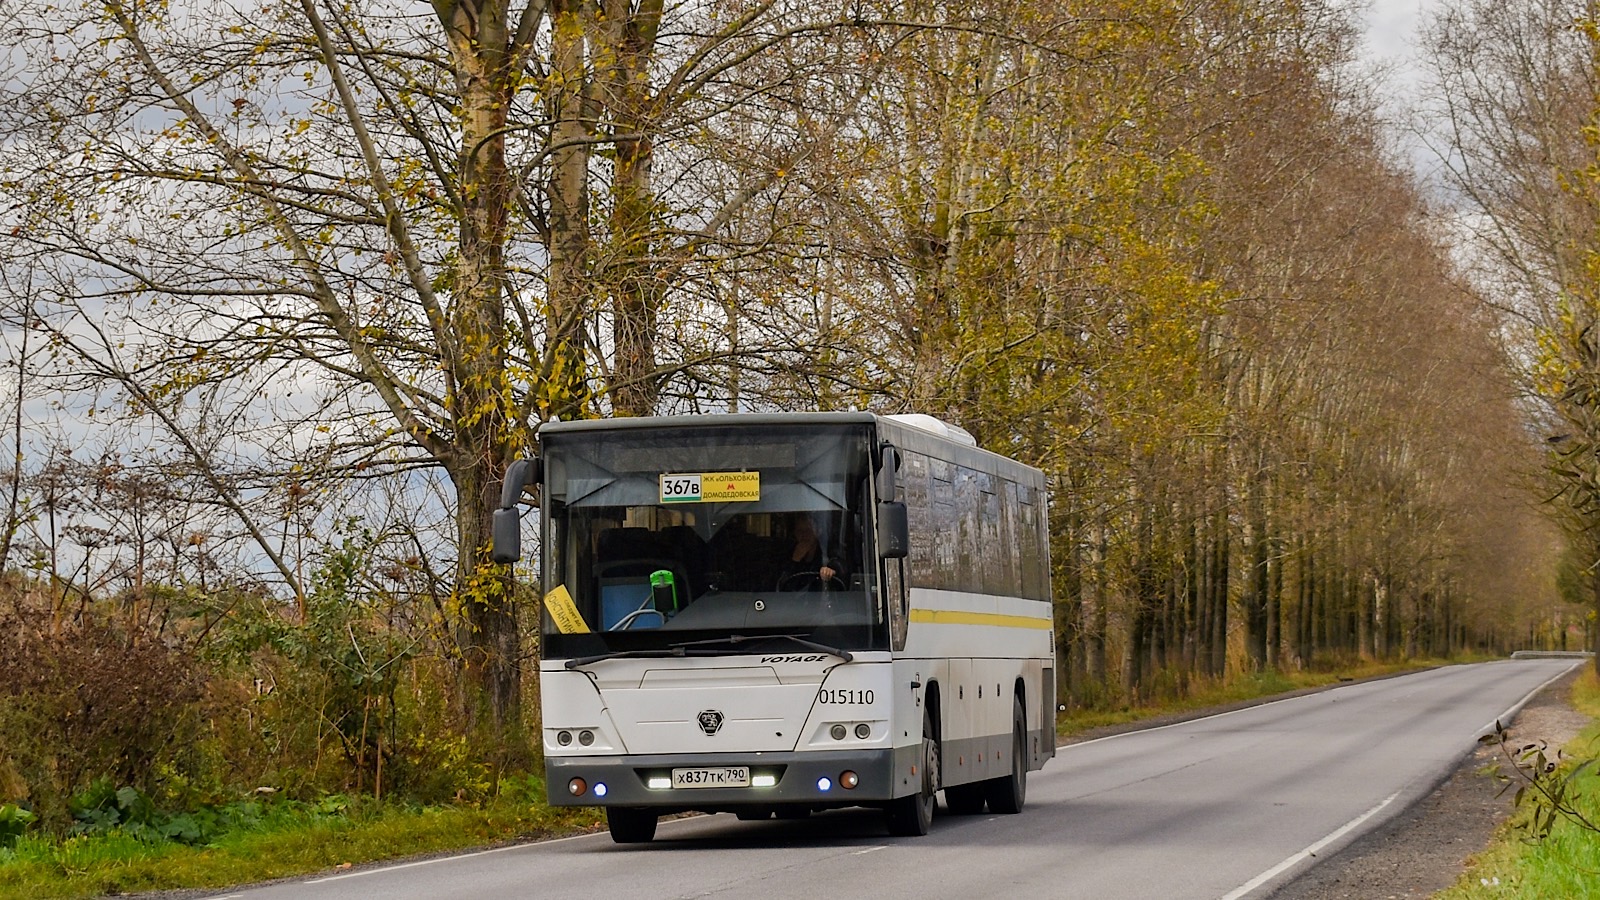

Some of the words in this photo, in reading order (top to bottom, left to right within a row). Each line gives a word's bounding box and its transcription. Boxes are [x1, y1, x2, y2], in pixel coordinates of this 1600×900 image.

[703, 491, 759, 499] ДОМОДЕДОВСКАЯ
[761, 655, 828, 663] VOYAGE
[820, 689, 874, 704] 015110
[726, 769, 745, 779] 790
